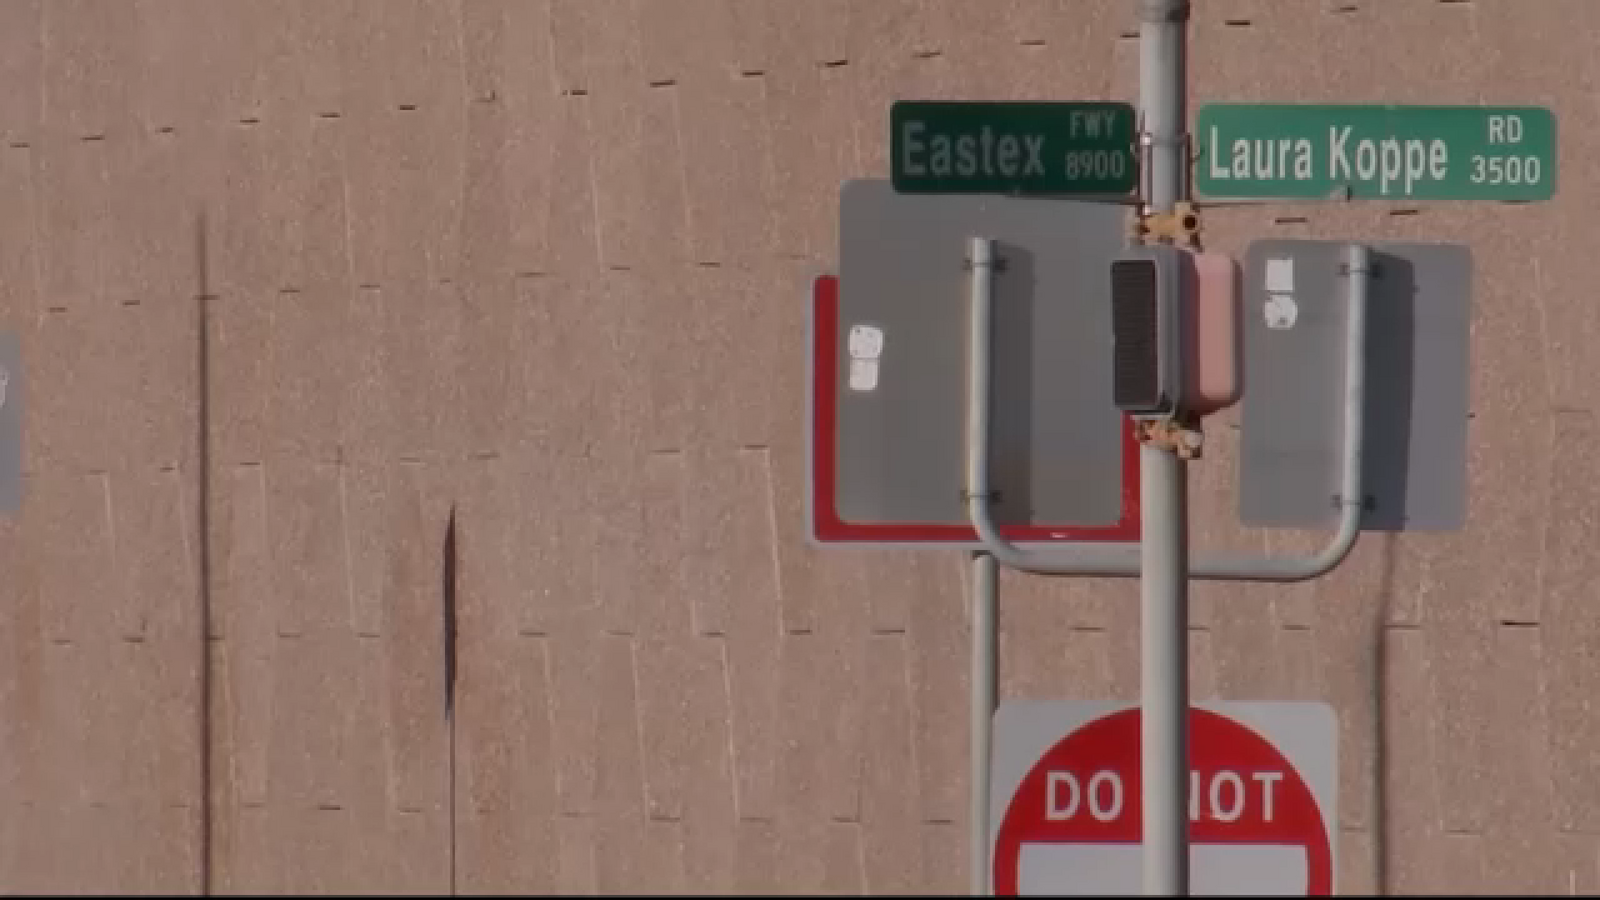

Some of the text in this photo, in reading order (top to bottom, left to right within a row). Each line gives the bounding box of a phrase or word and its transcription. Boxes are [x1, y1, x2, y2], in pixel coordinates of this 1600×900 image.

[1069, 109, 1116, 139] FWY
[1488, 114, 1523, 144] RD
[902, 120, 1046, 176] Eastex
[1209, 124, 1449, 196] Laura Koppe
[1064, 149, 1126, 181] 8900
[1469, 155, 1542, 186] 3500
[1045, 770, 1124, 822] DO
